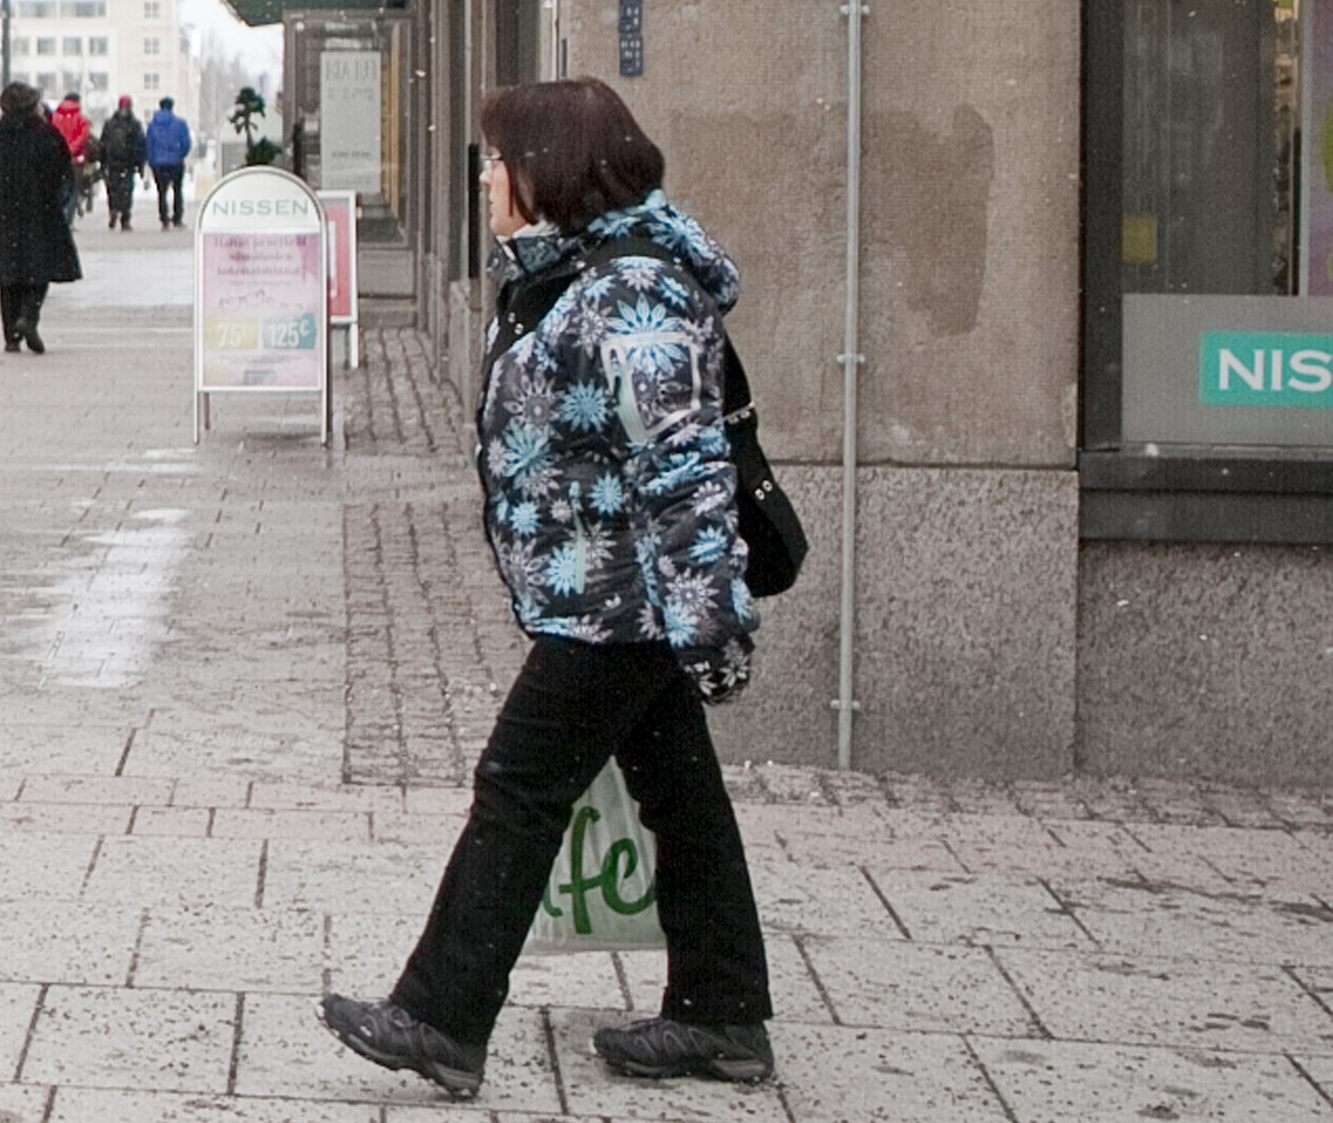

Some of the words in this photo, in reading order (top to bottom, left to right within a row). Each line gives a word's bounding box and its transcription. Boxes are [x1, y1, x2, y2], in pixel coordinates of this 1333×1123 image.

[213, 199, 309, 216] NISSEN
[269, 318, 310, 348] 125€
[1219, 348, 1333, 393] NIS
